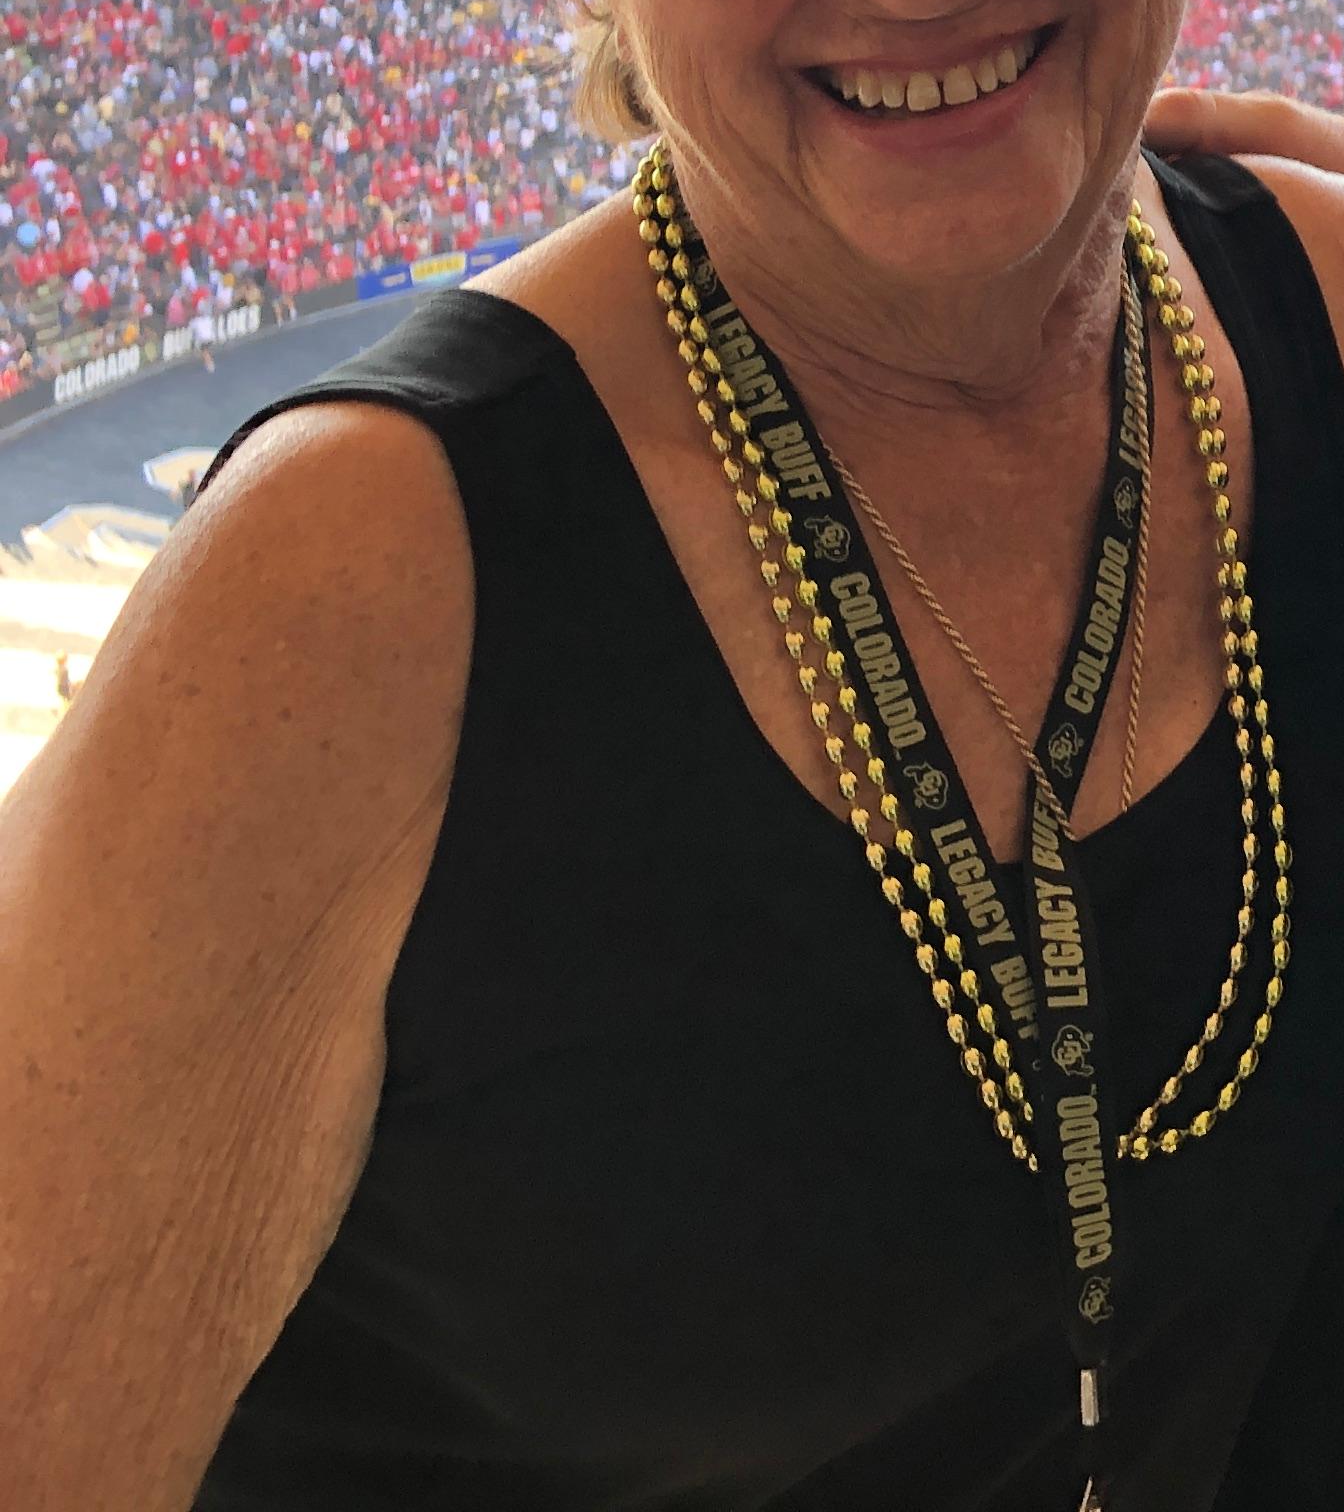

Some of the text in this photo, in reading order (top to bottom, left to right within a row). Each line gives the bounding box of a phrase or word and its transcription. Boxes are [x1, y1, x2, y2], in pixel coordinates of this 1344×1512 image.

[704, 301, 790, 418] LEGACY
[760, 420, 832, 500] BUFF
[830, 572, 927, 748] COLORADO
[930, 818, 1016, 946] LEGACY
[1064, 536, 1130, 715] COLORADO
[1034, 877, 1089, 1008] LEGACY
[1056, 1095, 1112, 1269] COLORADO
